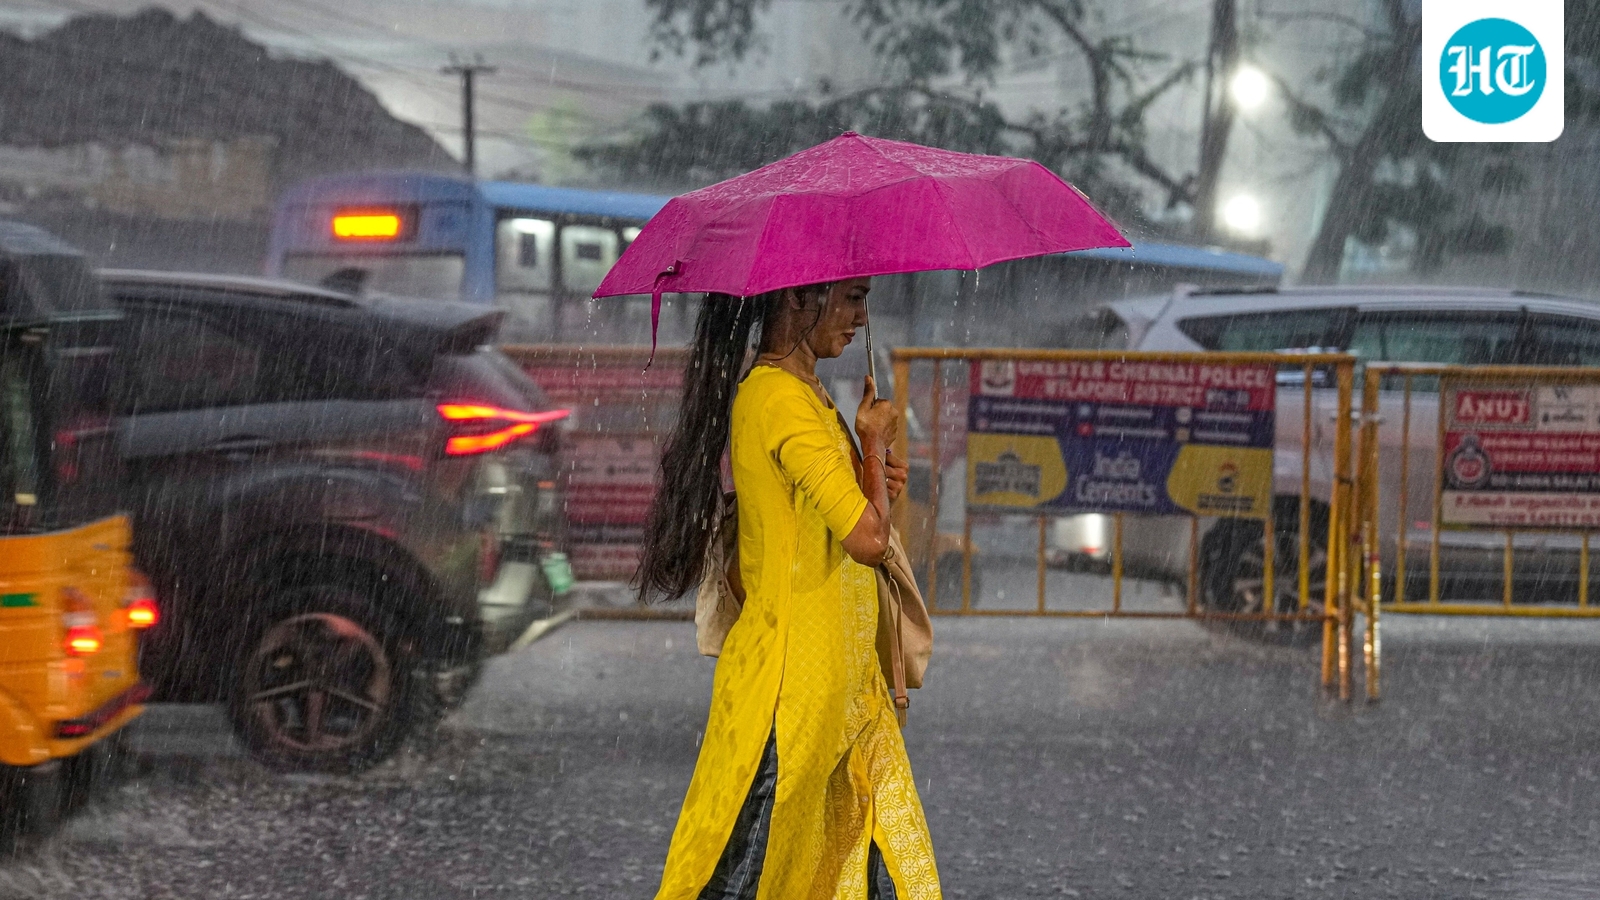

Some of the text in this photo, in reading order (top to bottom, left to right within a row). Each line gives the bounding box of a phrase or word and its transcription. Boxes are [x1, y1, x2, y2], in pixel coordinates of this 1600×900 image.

[1110, 363, 1195, 383] CHENNAI
[1199, 365, 1267, 387] POLICE
[1094, 450, 1140, 478] India
[1076, 474, 1157, 505] Cements
